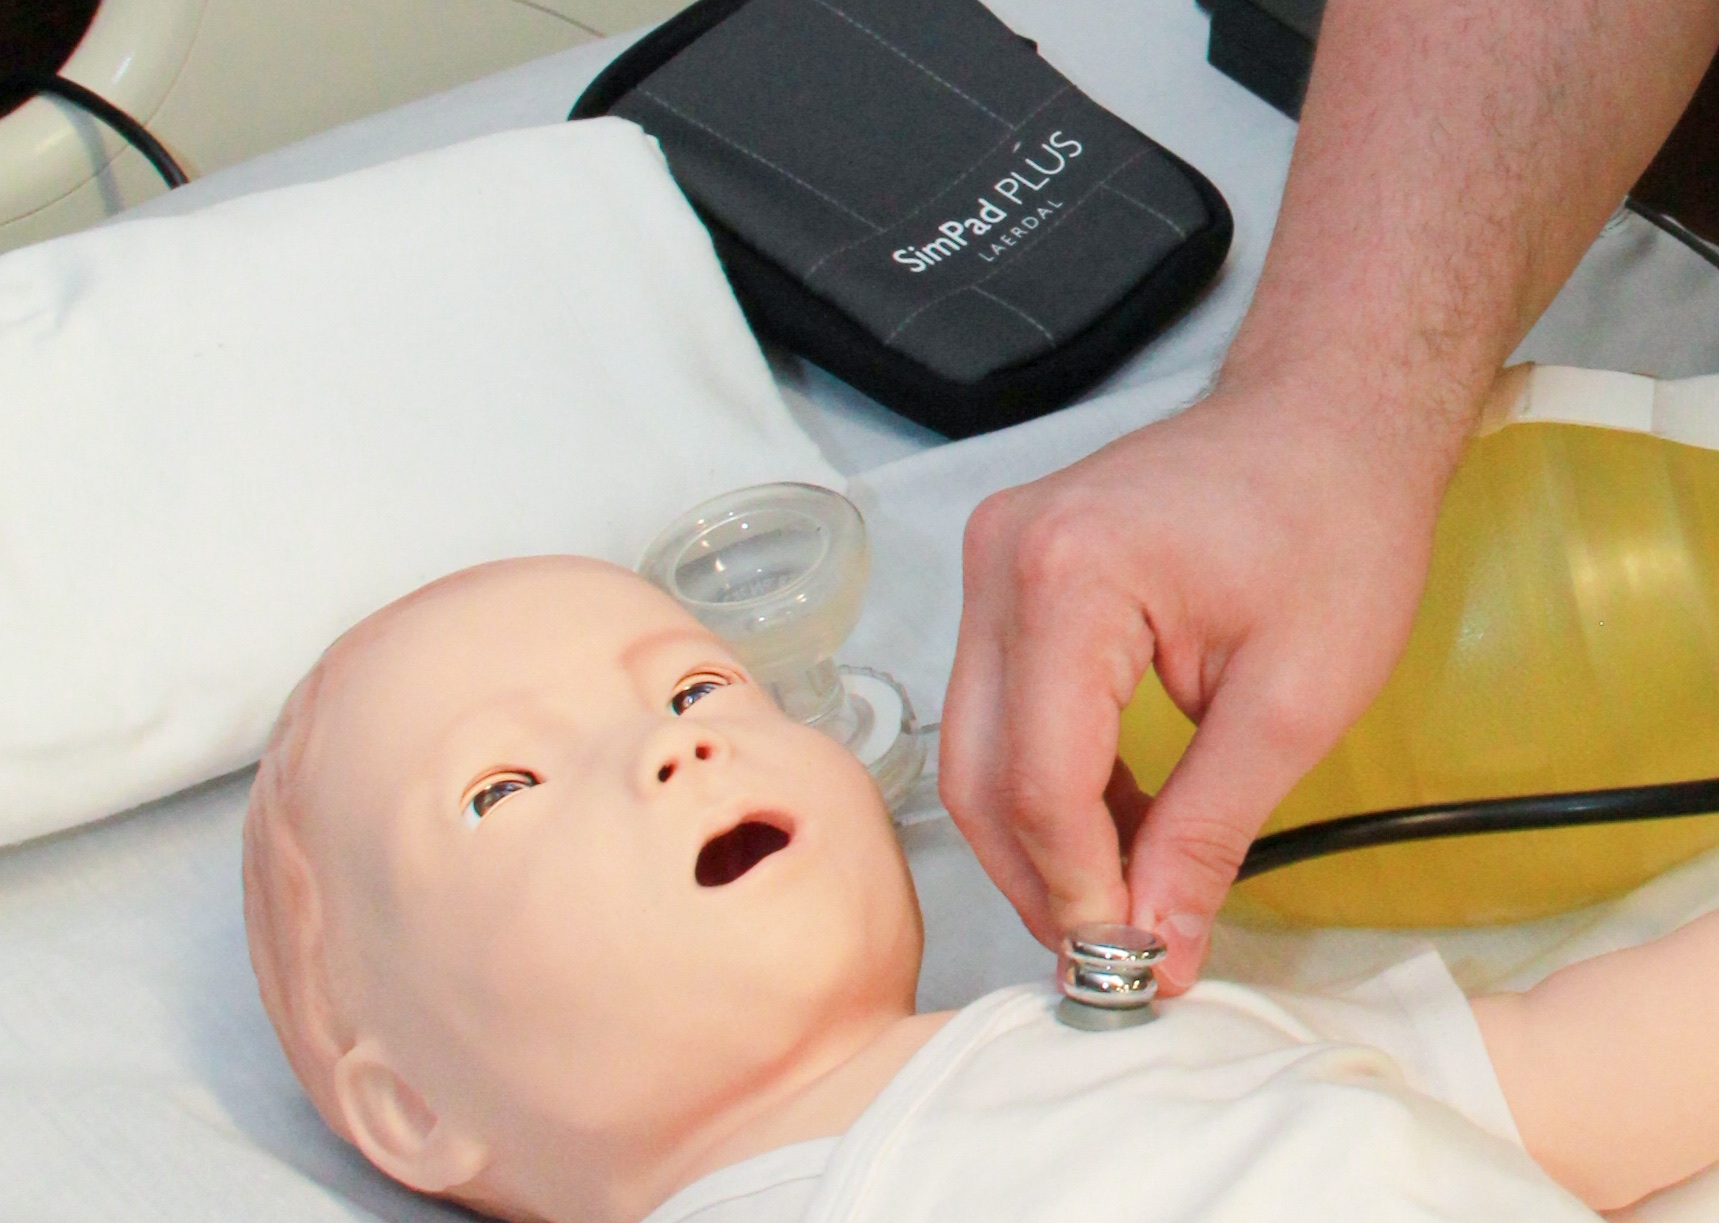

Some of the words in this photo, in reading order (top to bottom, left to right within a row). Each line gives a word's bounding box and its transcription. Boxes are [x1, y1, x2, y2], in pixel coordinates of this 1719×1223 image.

[892, 197, 1007, 273] SimPad
[994, 130, 1083, 206] PLUS
[978, 199, 1063, 263] LAERDAL
